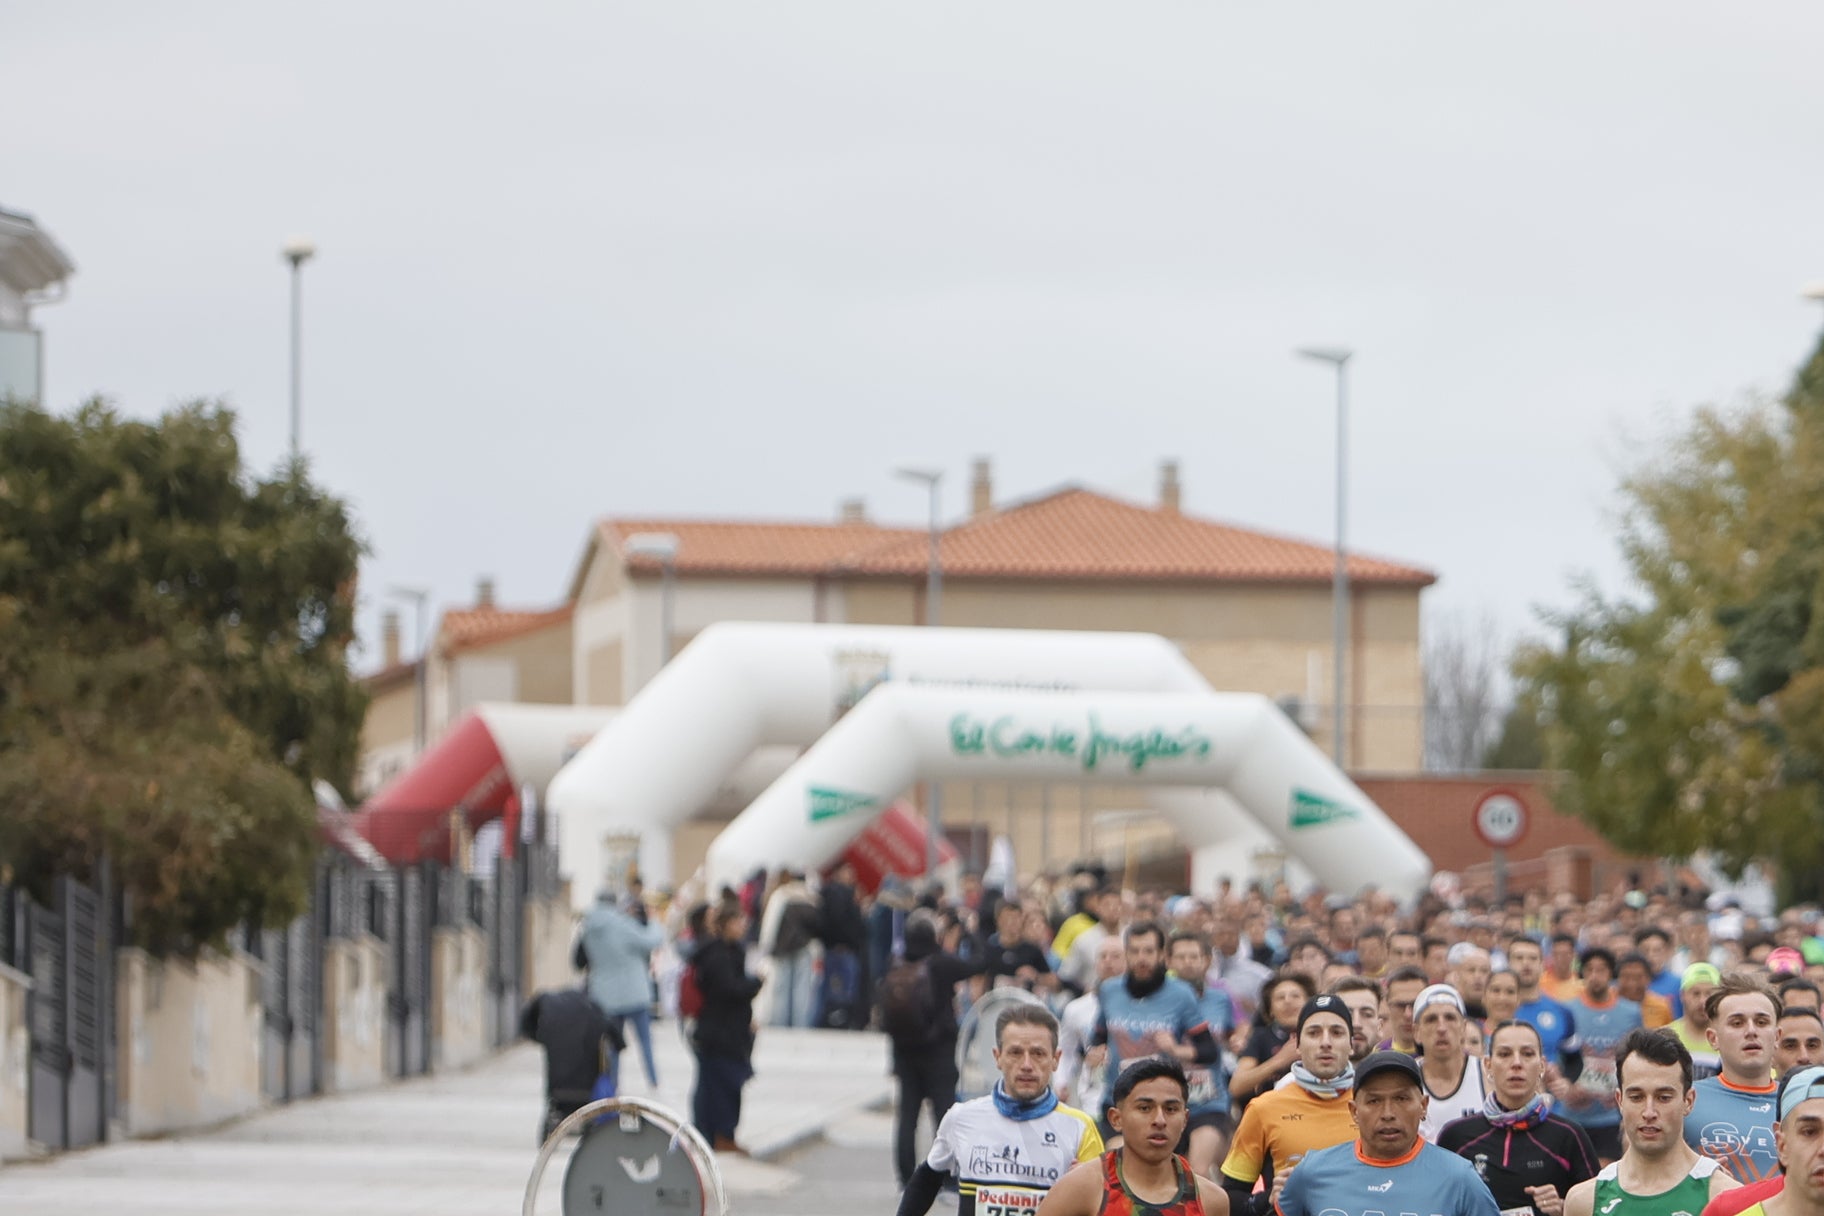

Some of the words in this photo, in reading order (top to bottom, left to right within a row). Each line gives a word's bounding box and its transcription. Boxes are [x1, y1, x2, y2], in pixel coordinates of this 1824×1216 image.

[949, 711, 984, 755] El
[988, 714, 1077, 757] Corte
[1701, 1122, 1778, 1158] SA
[1701, 1135, 1777, 1147] SILVE
